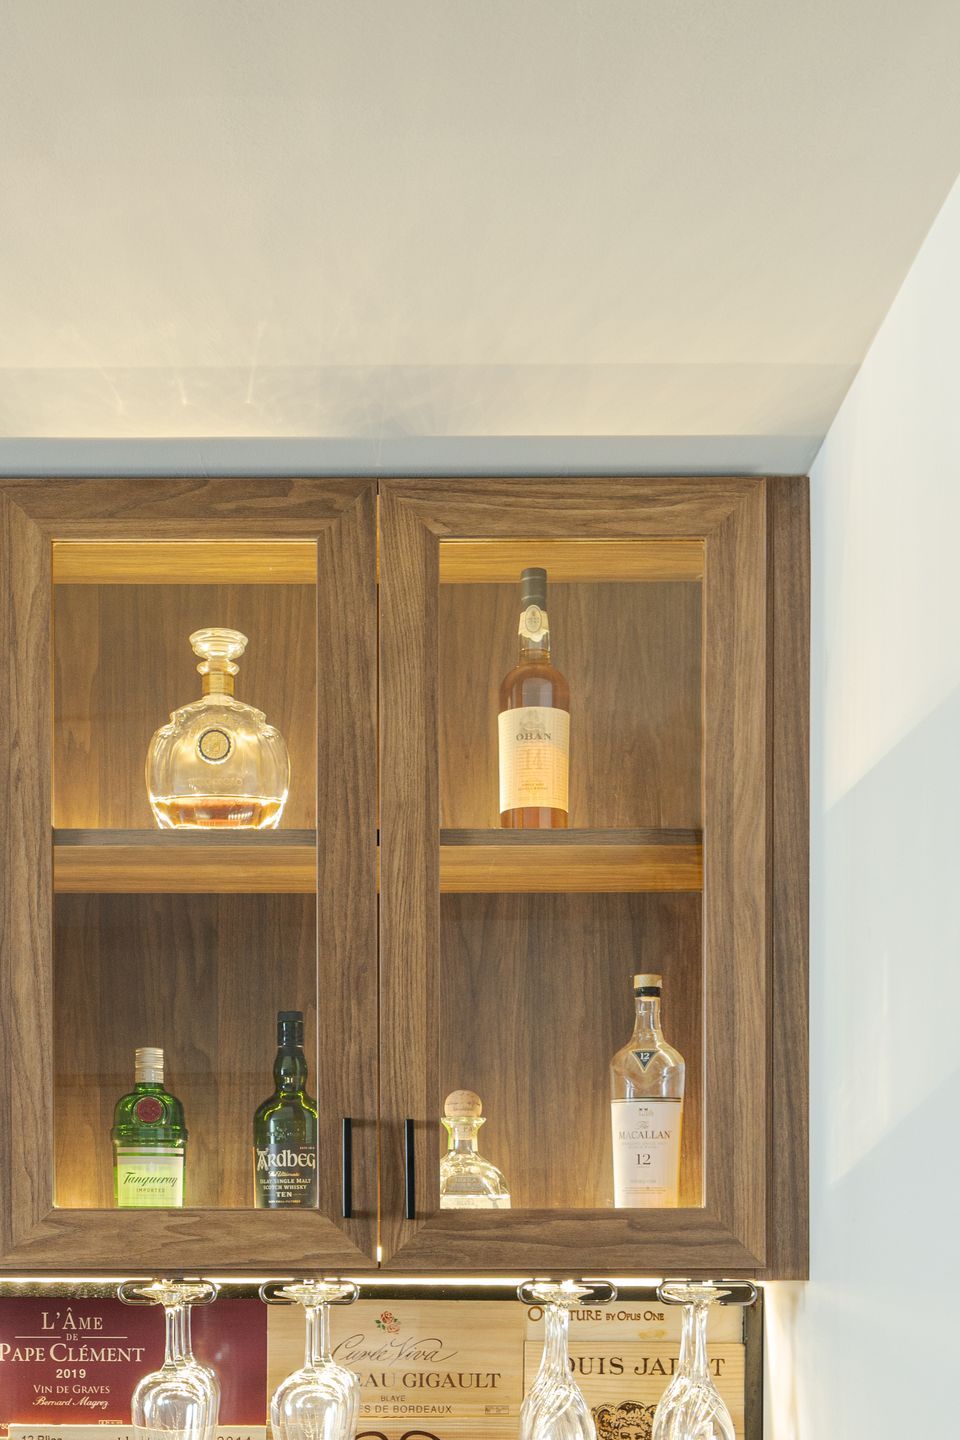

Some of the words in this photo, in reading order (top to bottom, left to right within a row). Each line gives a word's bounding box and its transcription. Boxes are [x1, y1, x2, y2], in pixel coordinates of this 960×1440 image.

[516, 732, 552, 741] OBAN
[640, 1051, 650, 1060] 12
[619, 1130, 672, 1140] MACALLAN
[636, 1153, 651, 1166] 12
[122, 1171, 178, 1187] Tanqueray
[617, 1310, 641, 1321] OPUS
[643, 1310, 665, 1321] ONE
[66, 1333, 79, 1341] DE
[49, 1341, 145, 1362] CLÉMENT
[55, 1368, 87, 1379] 2019
[402, 1372, 501, 1388] GIGAULT
[33, 1384, 54, 1394] VIN
[56, 1384, 71, 1394] DE
[72, 1384, 111, 1394] GRAVES
[32, 1396, 71, 1407] Bernard
[72, 1396, 109, 1410] Magrez
[380, 1394, 406, 1402] BLAYE
[375, 1405, 388, 1414] DE
[393, 1405, 453, 1414] BORDEAUX
